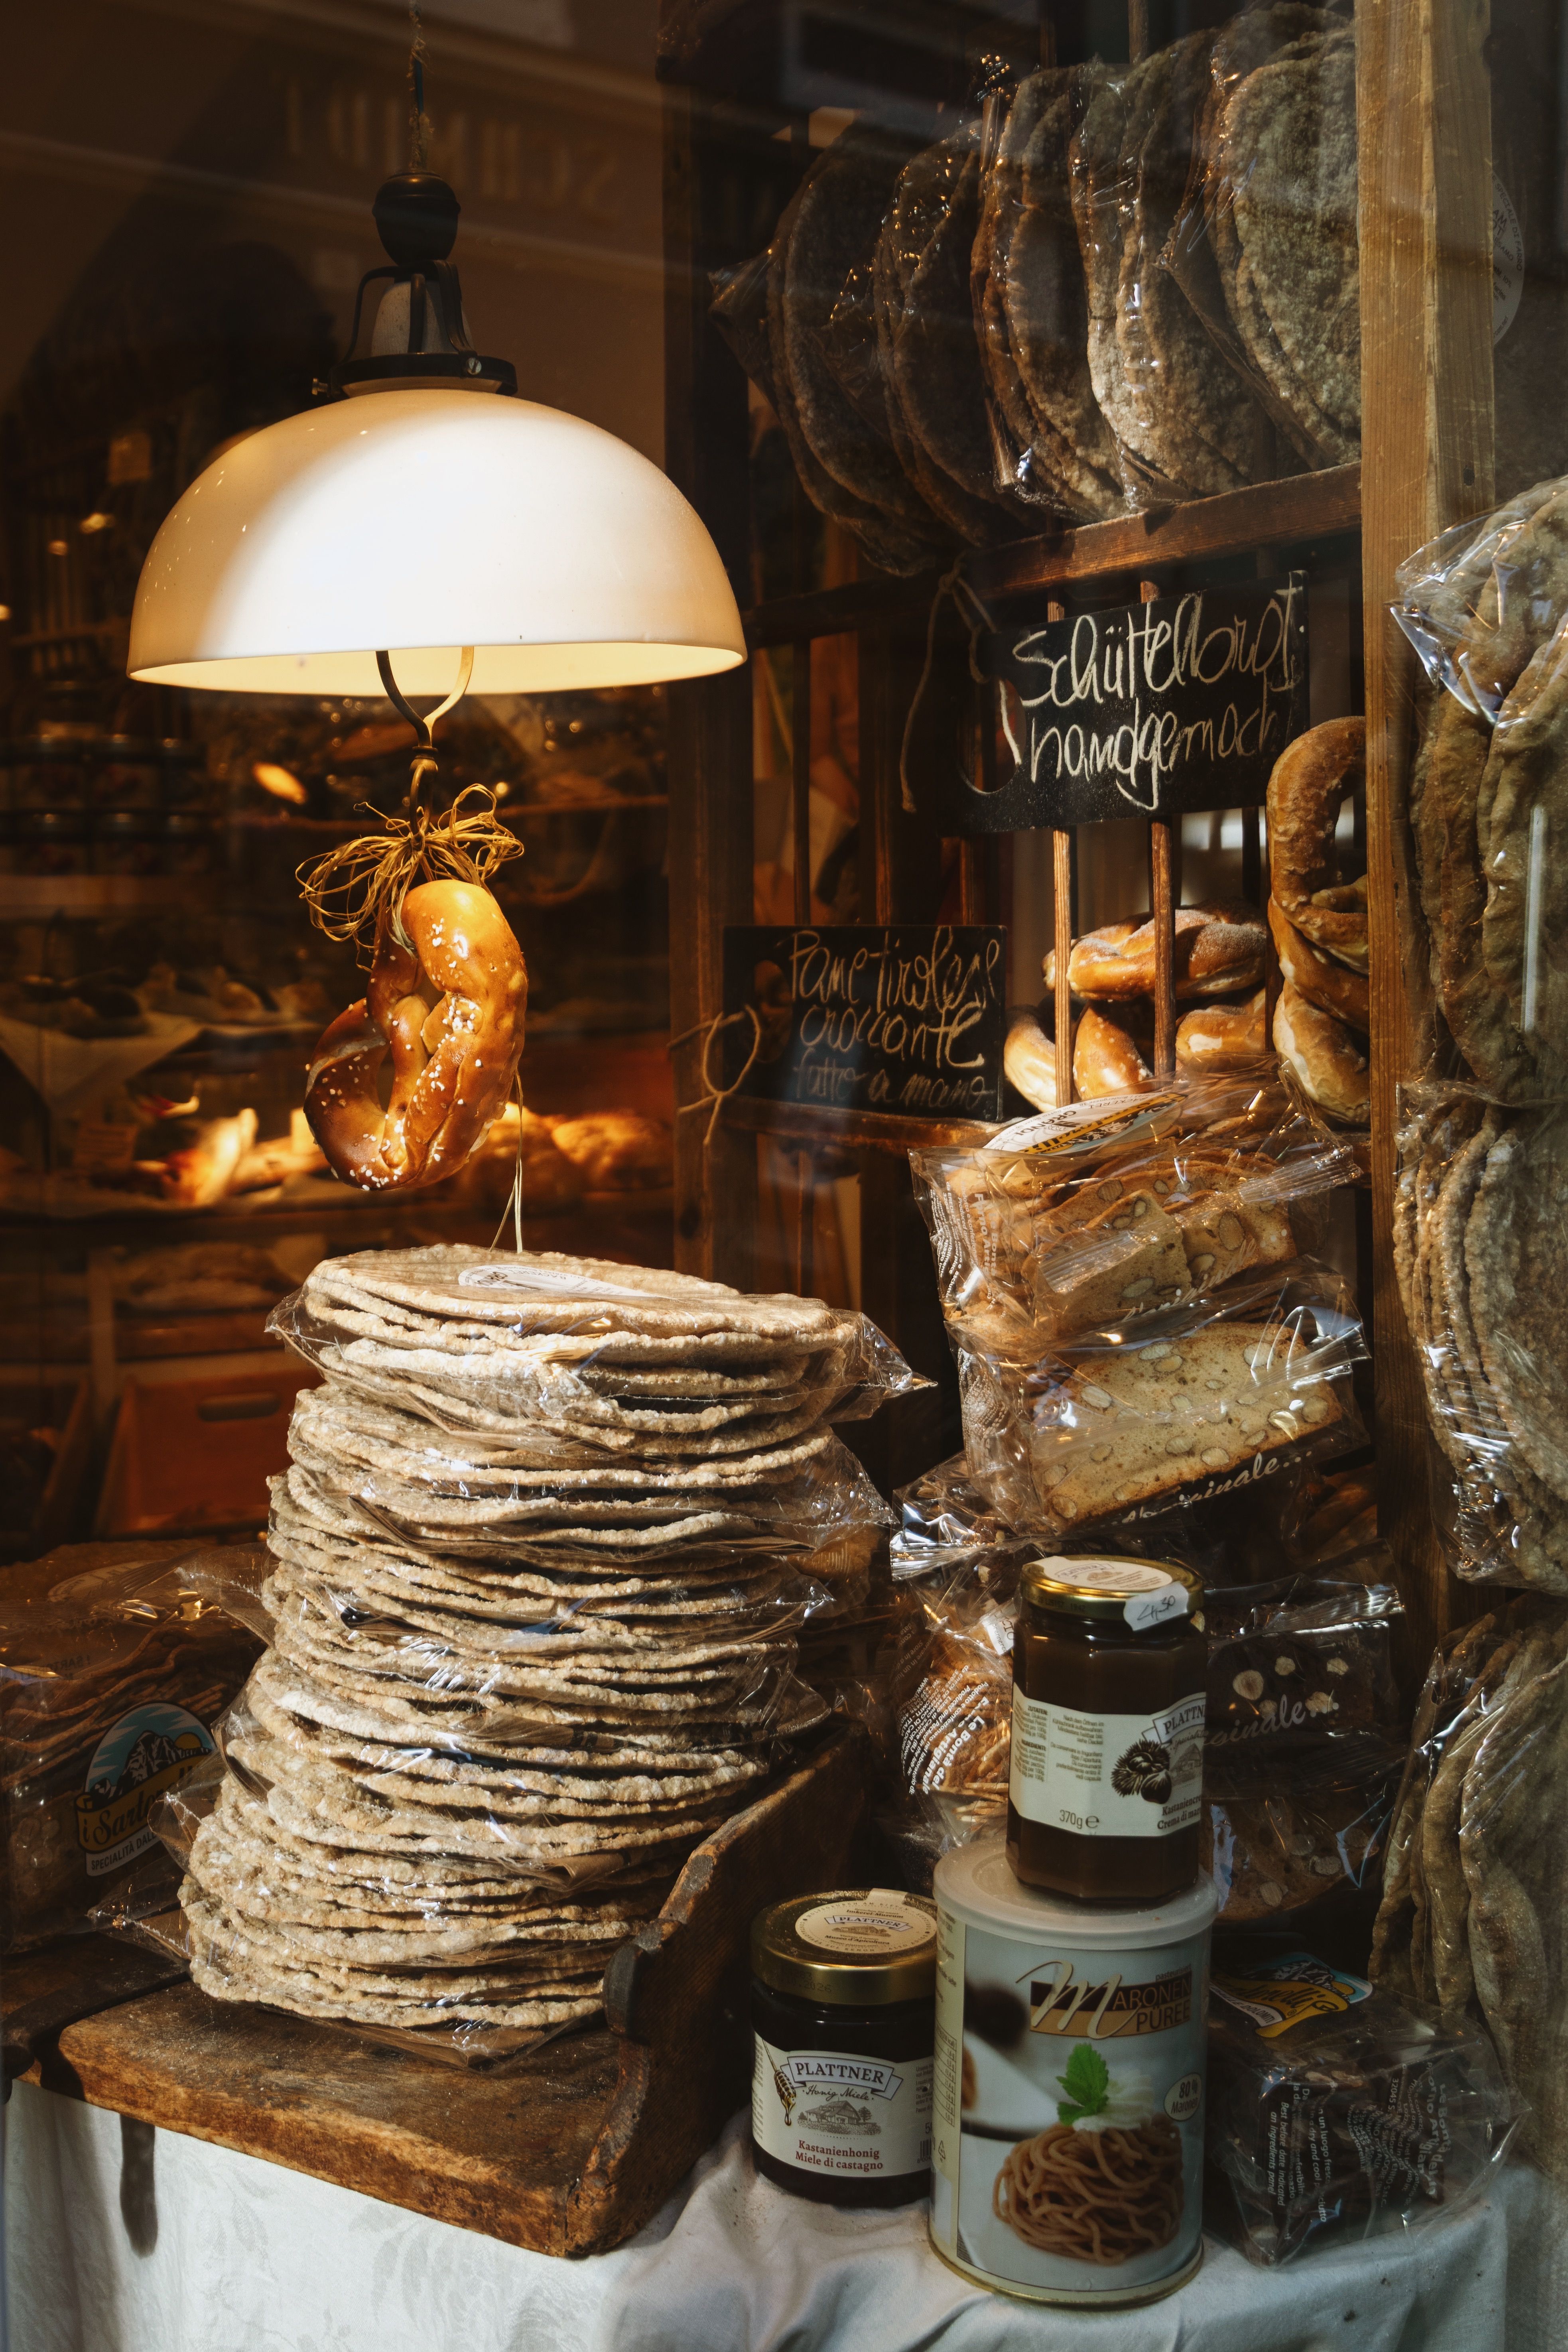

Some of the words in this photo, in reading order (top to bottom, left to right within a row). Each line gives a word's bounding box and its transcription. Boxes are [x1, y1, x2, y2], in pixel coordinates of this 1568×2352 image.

[1515, 240, 1523, 271] FARRO
[957, 1197, 967, 1230] Produced
[940, 1239, 949, 1262] spazio
[949, 1255, 957, 1275] place
[945, 1271, 959, 1298] asciutto
[949, 1673, 963, 1690] EREDI
[915, 1688, 939, 1717] DOLOMITI
[942, 1690, 949, 1699] DE
[948, 1685, 971, 1712] Produced
[965, 1681, 989, 1704] Prodotto
[909, 1701, 923, 1714] 0435
[921, 1693, 941, 1719] STEFANO
[927, 1698, 942, 1718] MARIO
[937, 1696, 951, 1712] Lozzo
[929, 1707, 961, 1741] confezionato
[938, 1709, 948, 1723] and
[968, 1715, 985, 1730] Le
[902, 1724, 914, 1751] CADORE
[909, 1718, 928, 1741] SARTOR
[916, 1719, 932, 1739] Cadore
[922, 1720, 940, 1741] Packed
[942, 1729, 971, 1766] Bontà
[911, 1751, 926, 1785] laboratorio
[922, 1728, 957, 1795] Artigianale
[932, 1767, 944, 1791] del
[83, 1818, 91, 1843] i
[1157, 1816, 1180, 1830] Crema
[1180, 1810, 1187, 1822] di
[91, 1841, 135, 1870] SPECIALITÀ
[839, 1917, 901, 1928] PLATTNER
[1136, 1999, 1190, 2032] PÜREE
[1241, 2005, 1275, 2023] DOLOMITI
[795, 2062, 884, 2084] PLATTNER
[806, 2084, 838, 2102] Honig
[840, 2087, 870, 2101] Miele
[1178, 2080, 1190, 2099] 80
[1302, 2088, 1310, 2100] Da
[1389, 2078, 1399, 2103] 32045
[1439, 2084, 1446, 2103] Le
[1271, 2112, 1277, 2122] an
[1281, 2102, 1289, 2120] Best
[1318, 2116, 1326, 2128] un
[1279, 2122, 1288, 2147] before
[1321, 2131, 1329, 2157] luogo
[798, 2140, 880, 2160] Kastanienhonig
[1268, 2125, 1278, 2169] ingredients
[1310, 2143, 1320, 2161] and
[795, 2151, 822, 2166] Miele
[823, 2158, 834, 2167] di
[836, 2161, 883, 2172] castagno
[1278, 2149, 1287, 2167] date
[1312, 2162, 1322, 2181] cool
[1386, 2163, 1397, 2184] ENNO
[1267, 2171, 1276, 2195] panel
